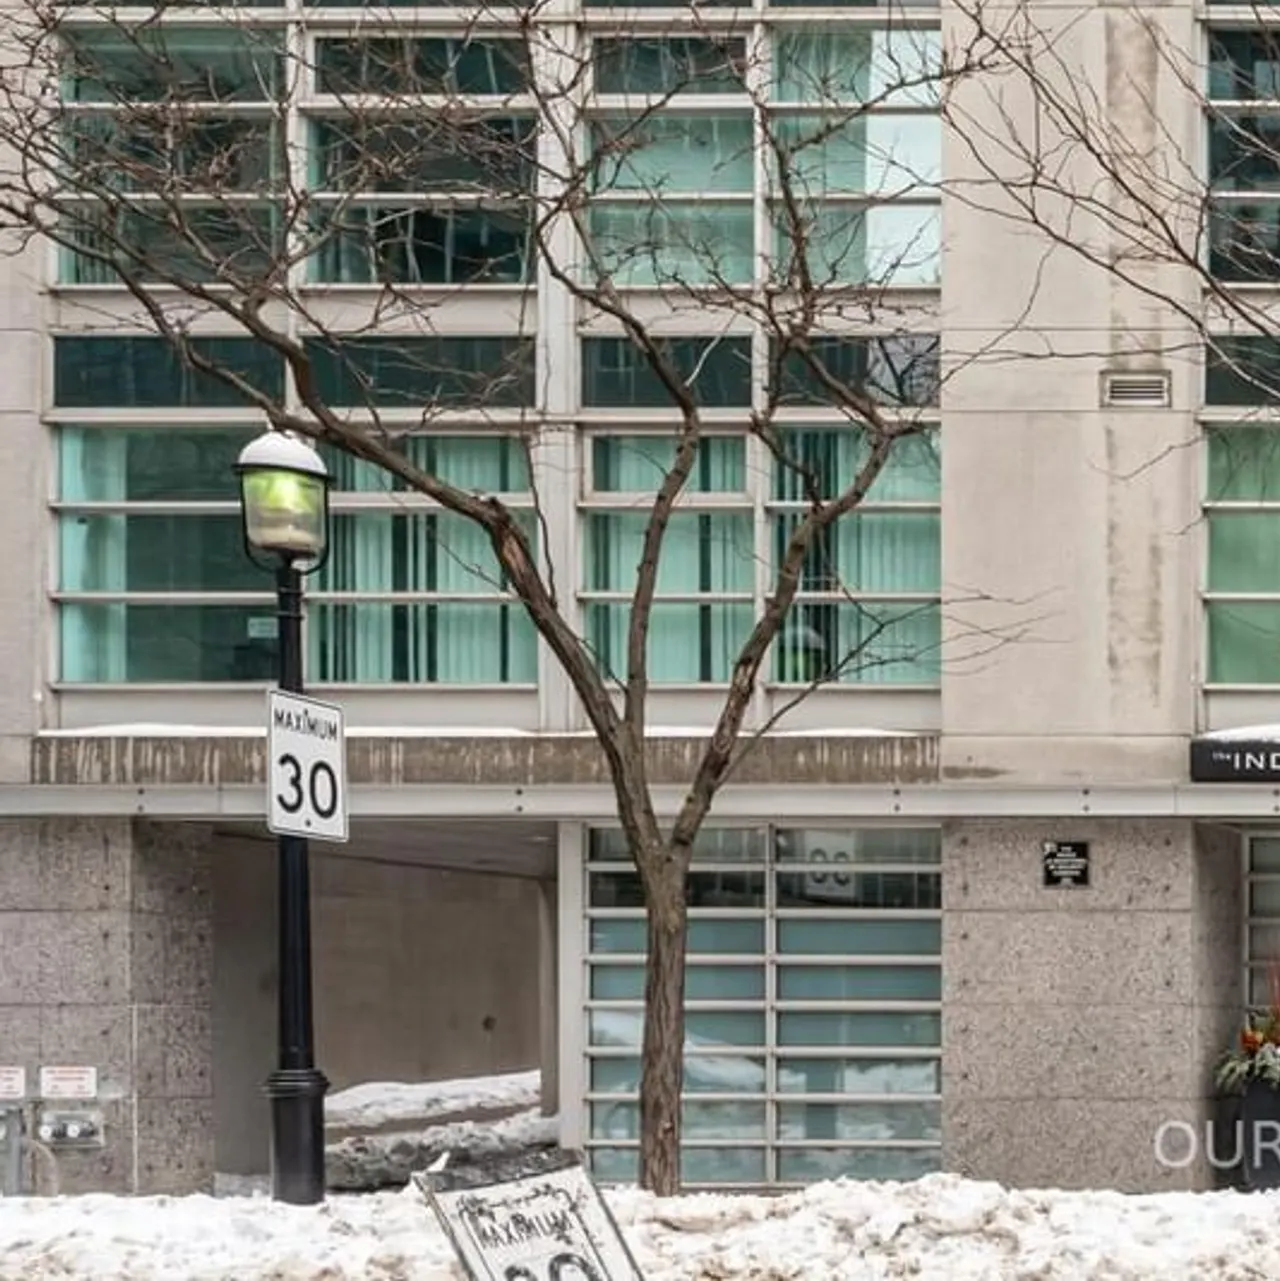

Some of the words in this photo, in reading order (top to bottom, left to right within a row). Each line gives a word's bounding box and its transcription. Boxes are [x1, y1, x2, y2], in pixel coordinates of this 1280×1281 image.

[274, 707, 337, 741] MAXIMUM
[277, 753, 337, 819] 30
[474, 1209, 574, 1251] MAXIMUM
